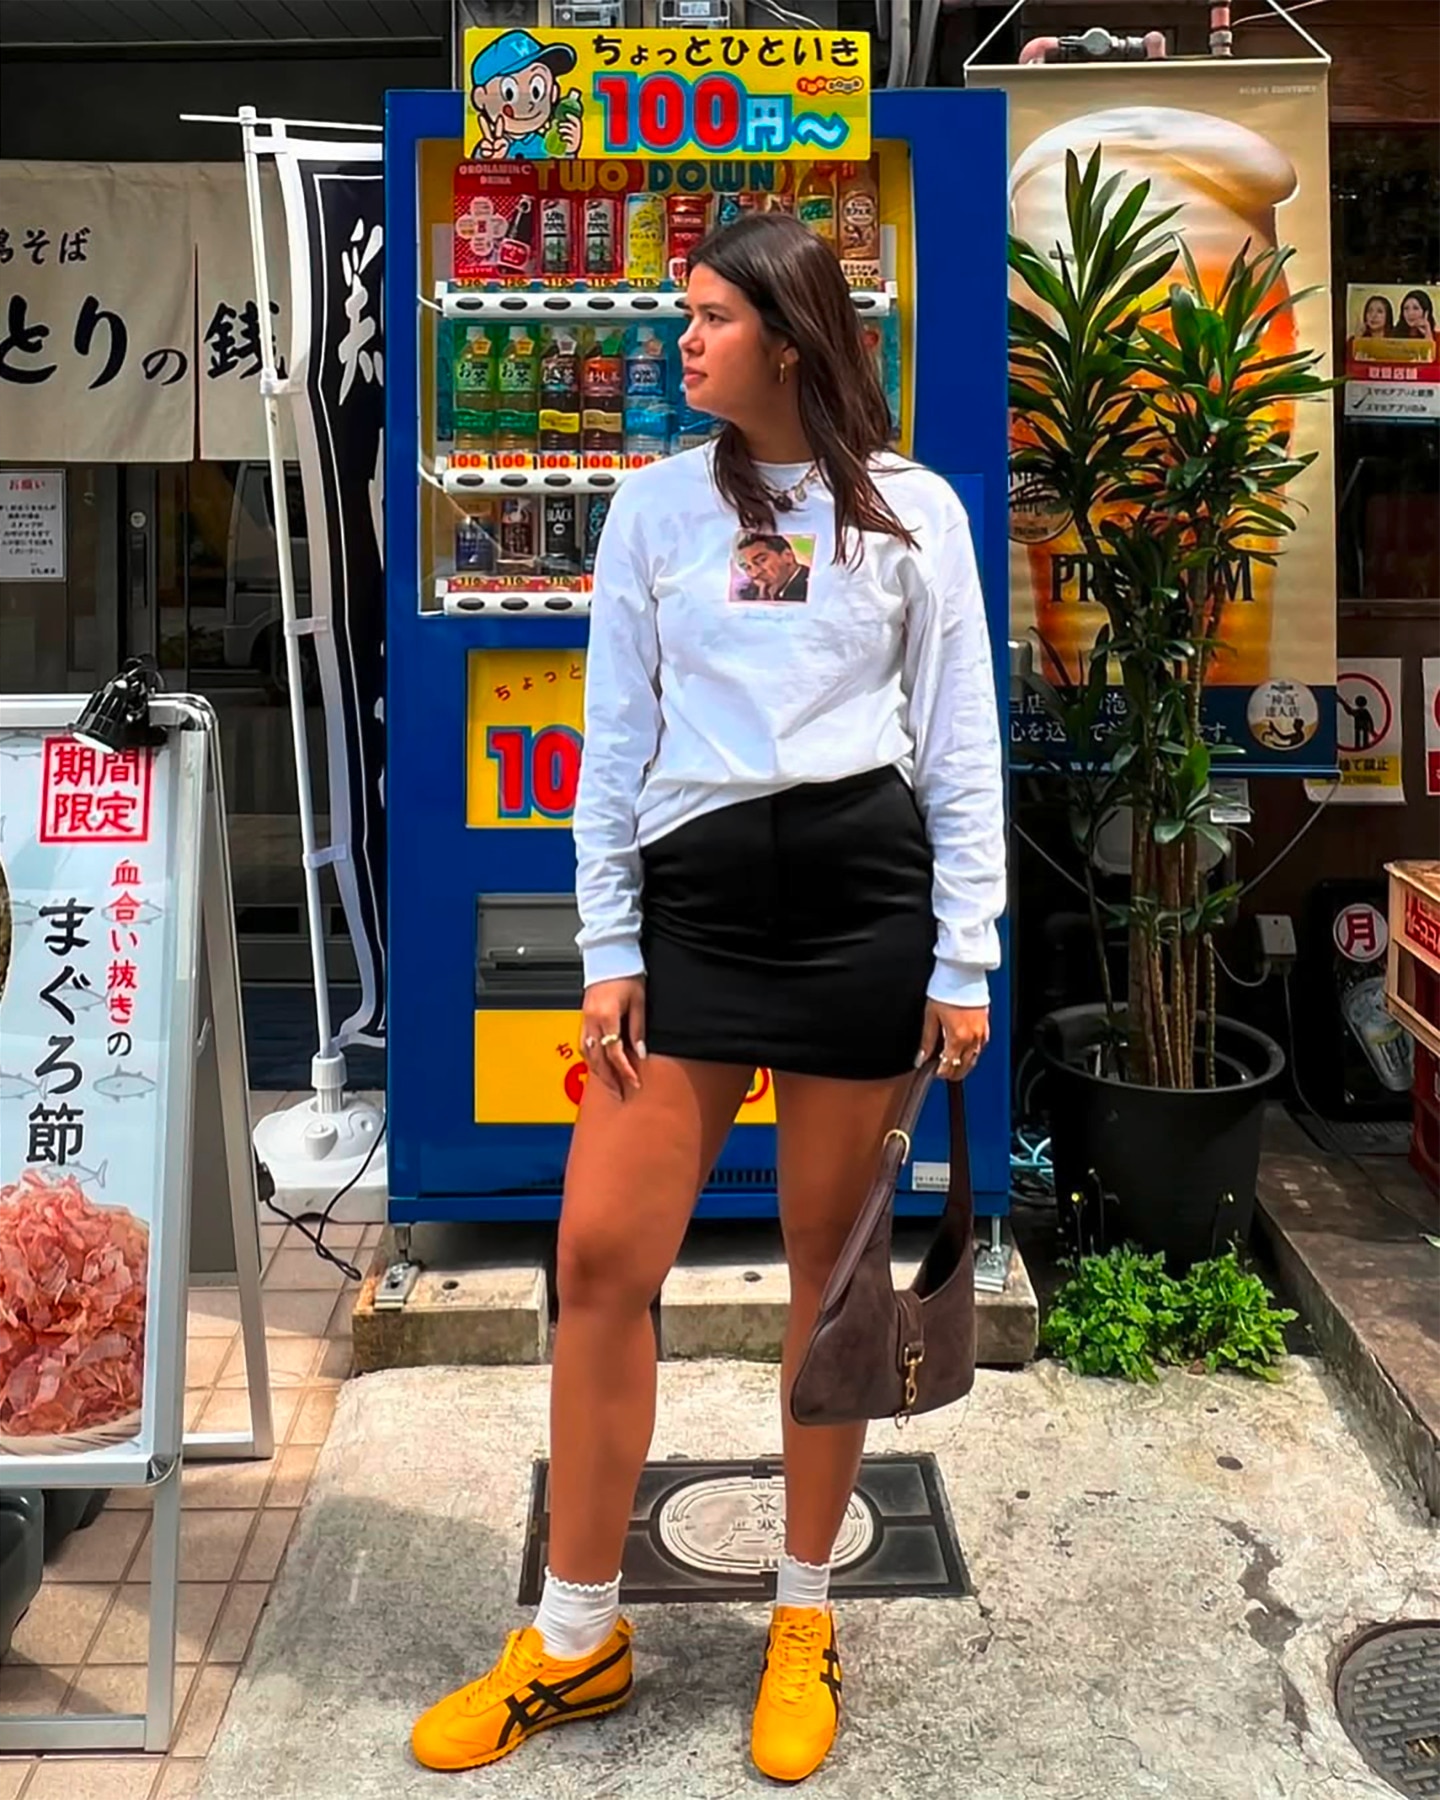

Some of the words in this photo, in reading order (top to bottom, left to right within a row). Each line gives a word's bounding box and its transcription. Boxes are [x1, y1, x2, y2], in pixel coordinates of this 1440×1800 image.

[592, 34, 859, 67] ちょっとひといき
[534, 160, 629, 192] TWO
[647, 160, 775, 193] DOWN
[451, 453, 481, 469] 100
[495, 453, 526, 469] 100
[540, 453, 570, 469] 100
[583, 453, 614, 469] 100
[547, 509, 572, 522] BLACK
[494, 663, 582, 701] ちょっと
[53, 744, 141, 787] 期間
[53, 790, 137, 834] 限定
[1344, 911, 1377, 953] 月
[106, 858, 142, 1057] 血合い抜きの
[26, 897, 95, 1167] まぐろ節
